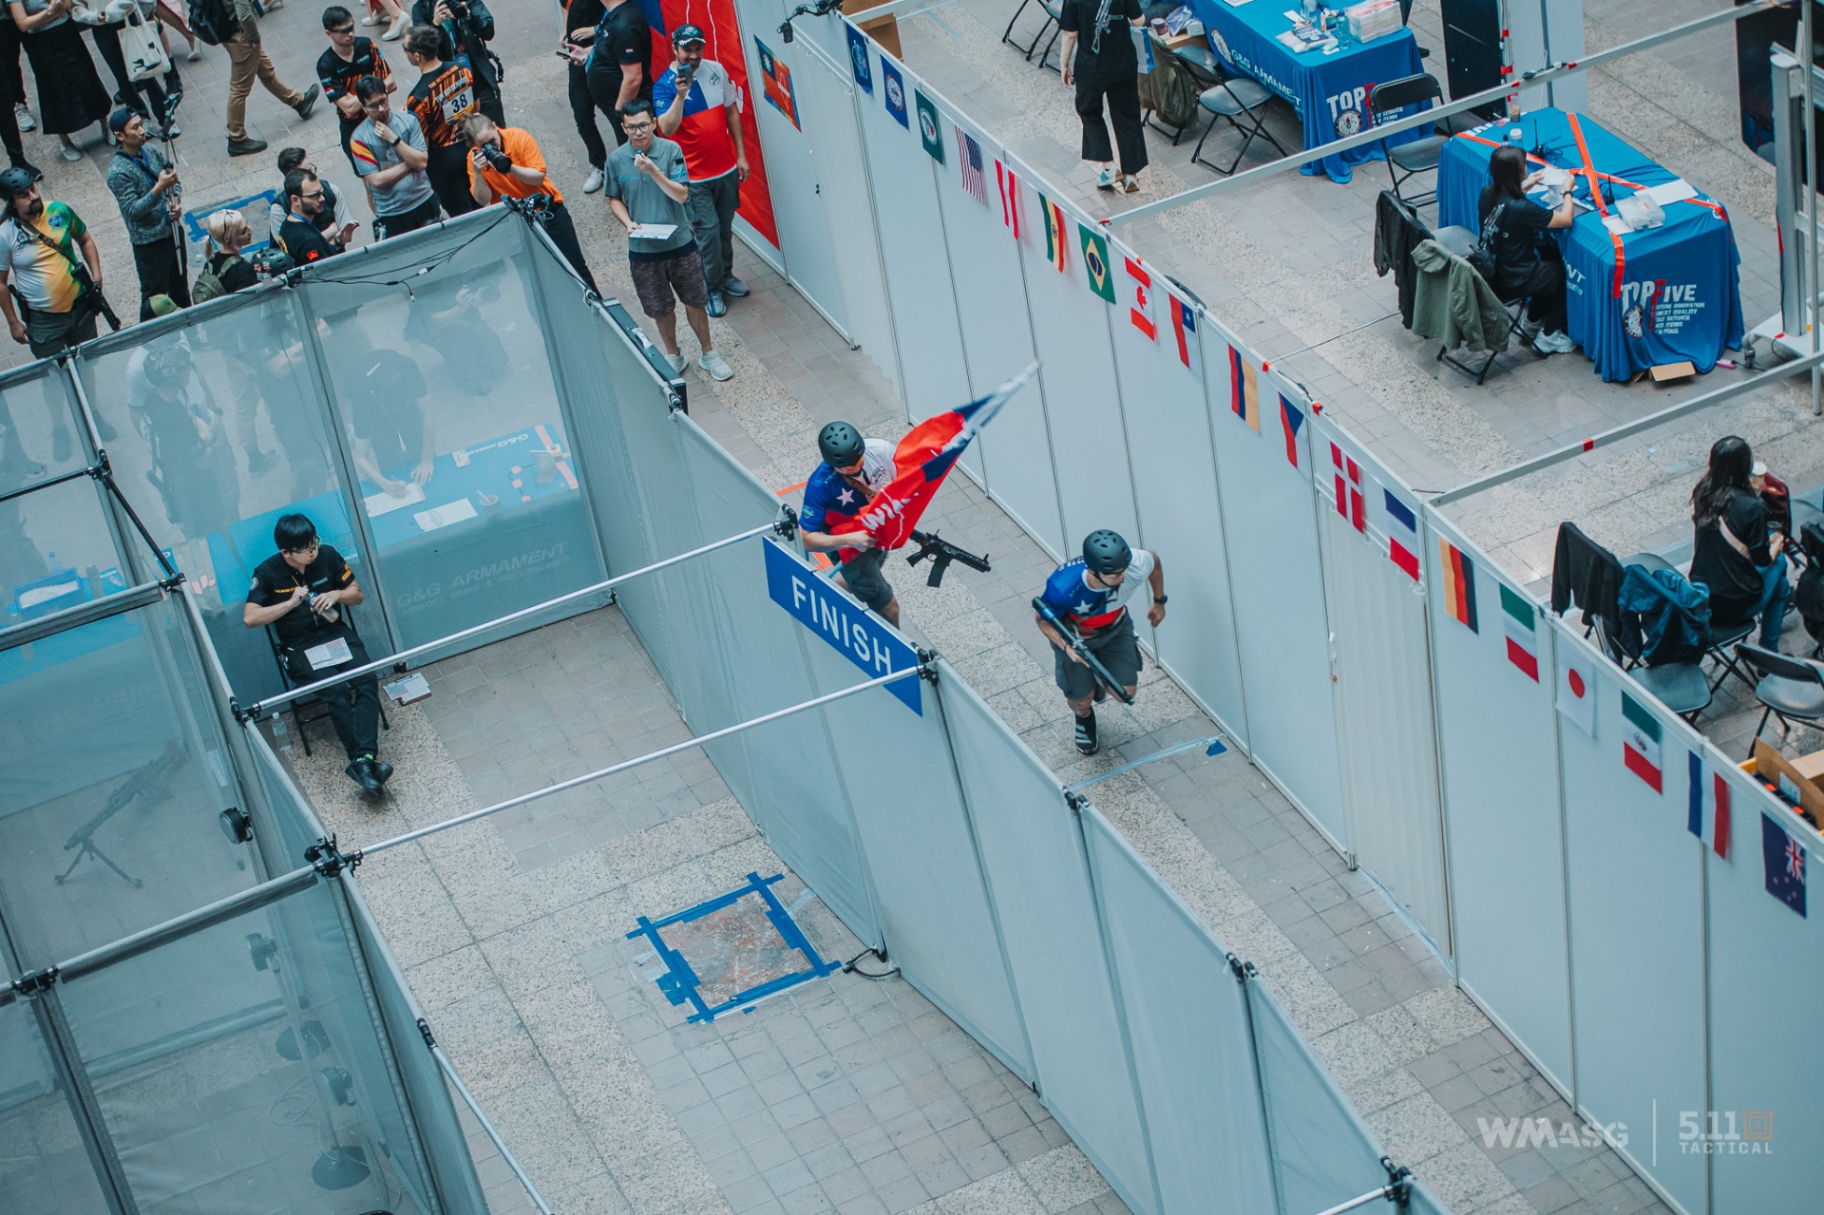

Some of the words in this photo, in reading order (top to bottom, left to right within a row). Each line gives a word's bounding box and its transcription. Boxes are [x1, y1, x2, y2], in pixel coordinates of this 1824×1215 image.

[451, 94, 468, 113] 38
[396, 582, 442, 608] G&G
[452, 541, 568, 589] ARMAMENT
[791, 574, 893, 675] FINISH
